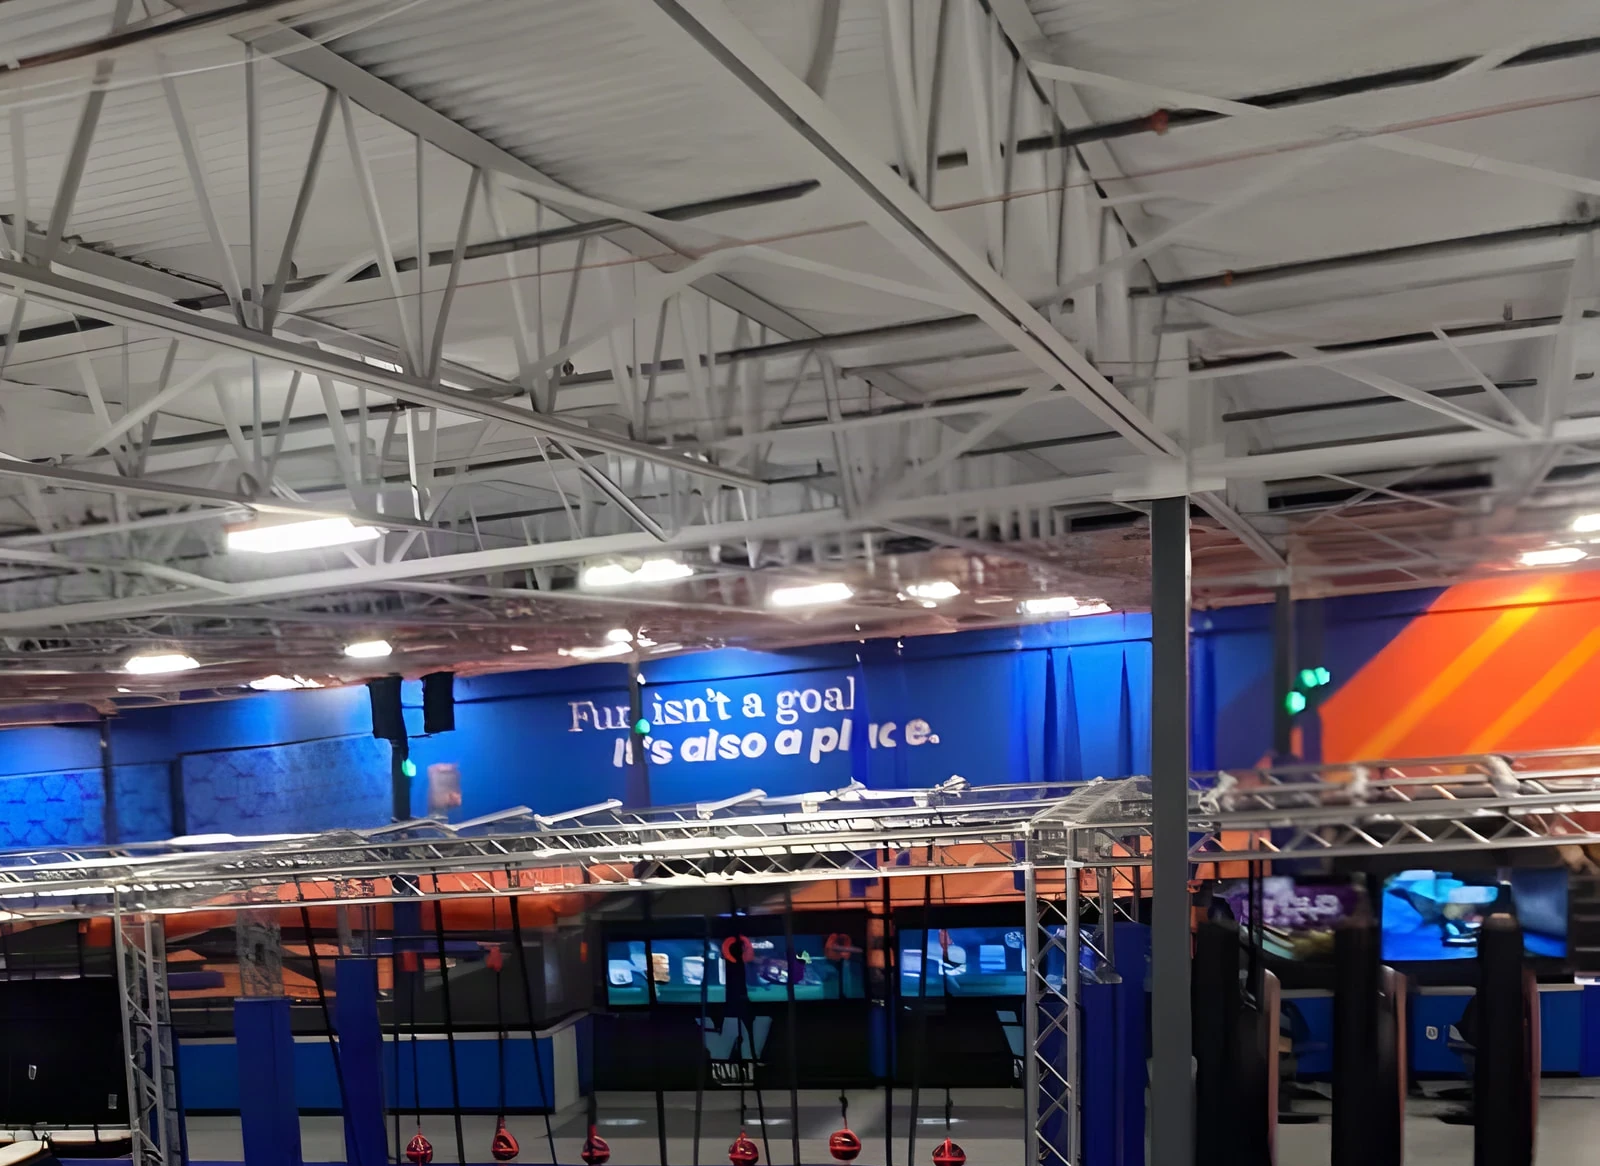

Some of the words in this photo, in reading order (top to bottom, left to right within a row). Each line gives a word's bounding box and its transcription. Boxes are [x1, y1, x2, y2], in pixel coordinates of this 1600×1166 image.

[652, 687, 732, 725] isn't
[742, 692, 766, 718] a
[775, 676, 855, 725] goal
[680, 728, 768, 763] also
[774, 729, 803, 756] a
